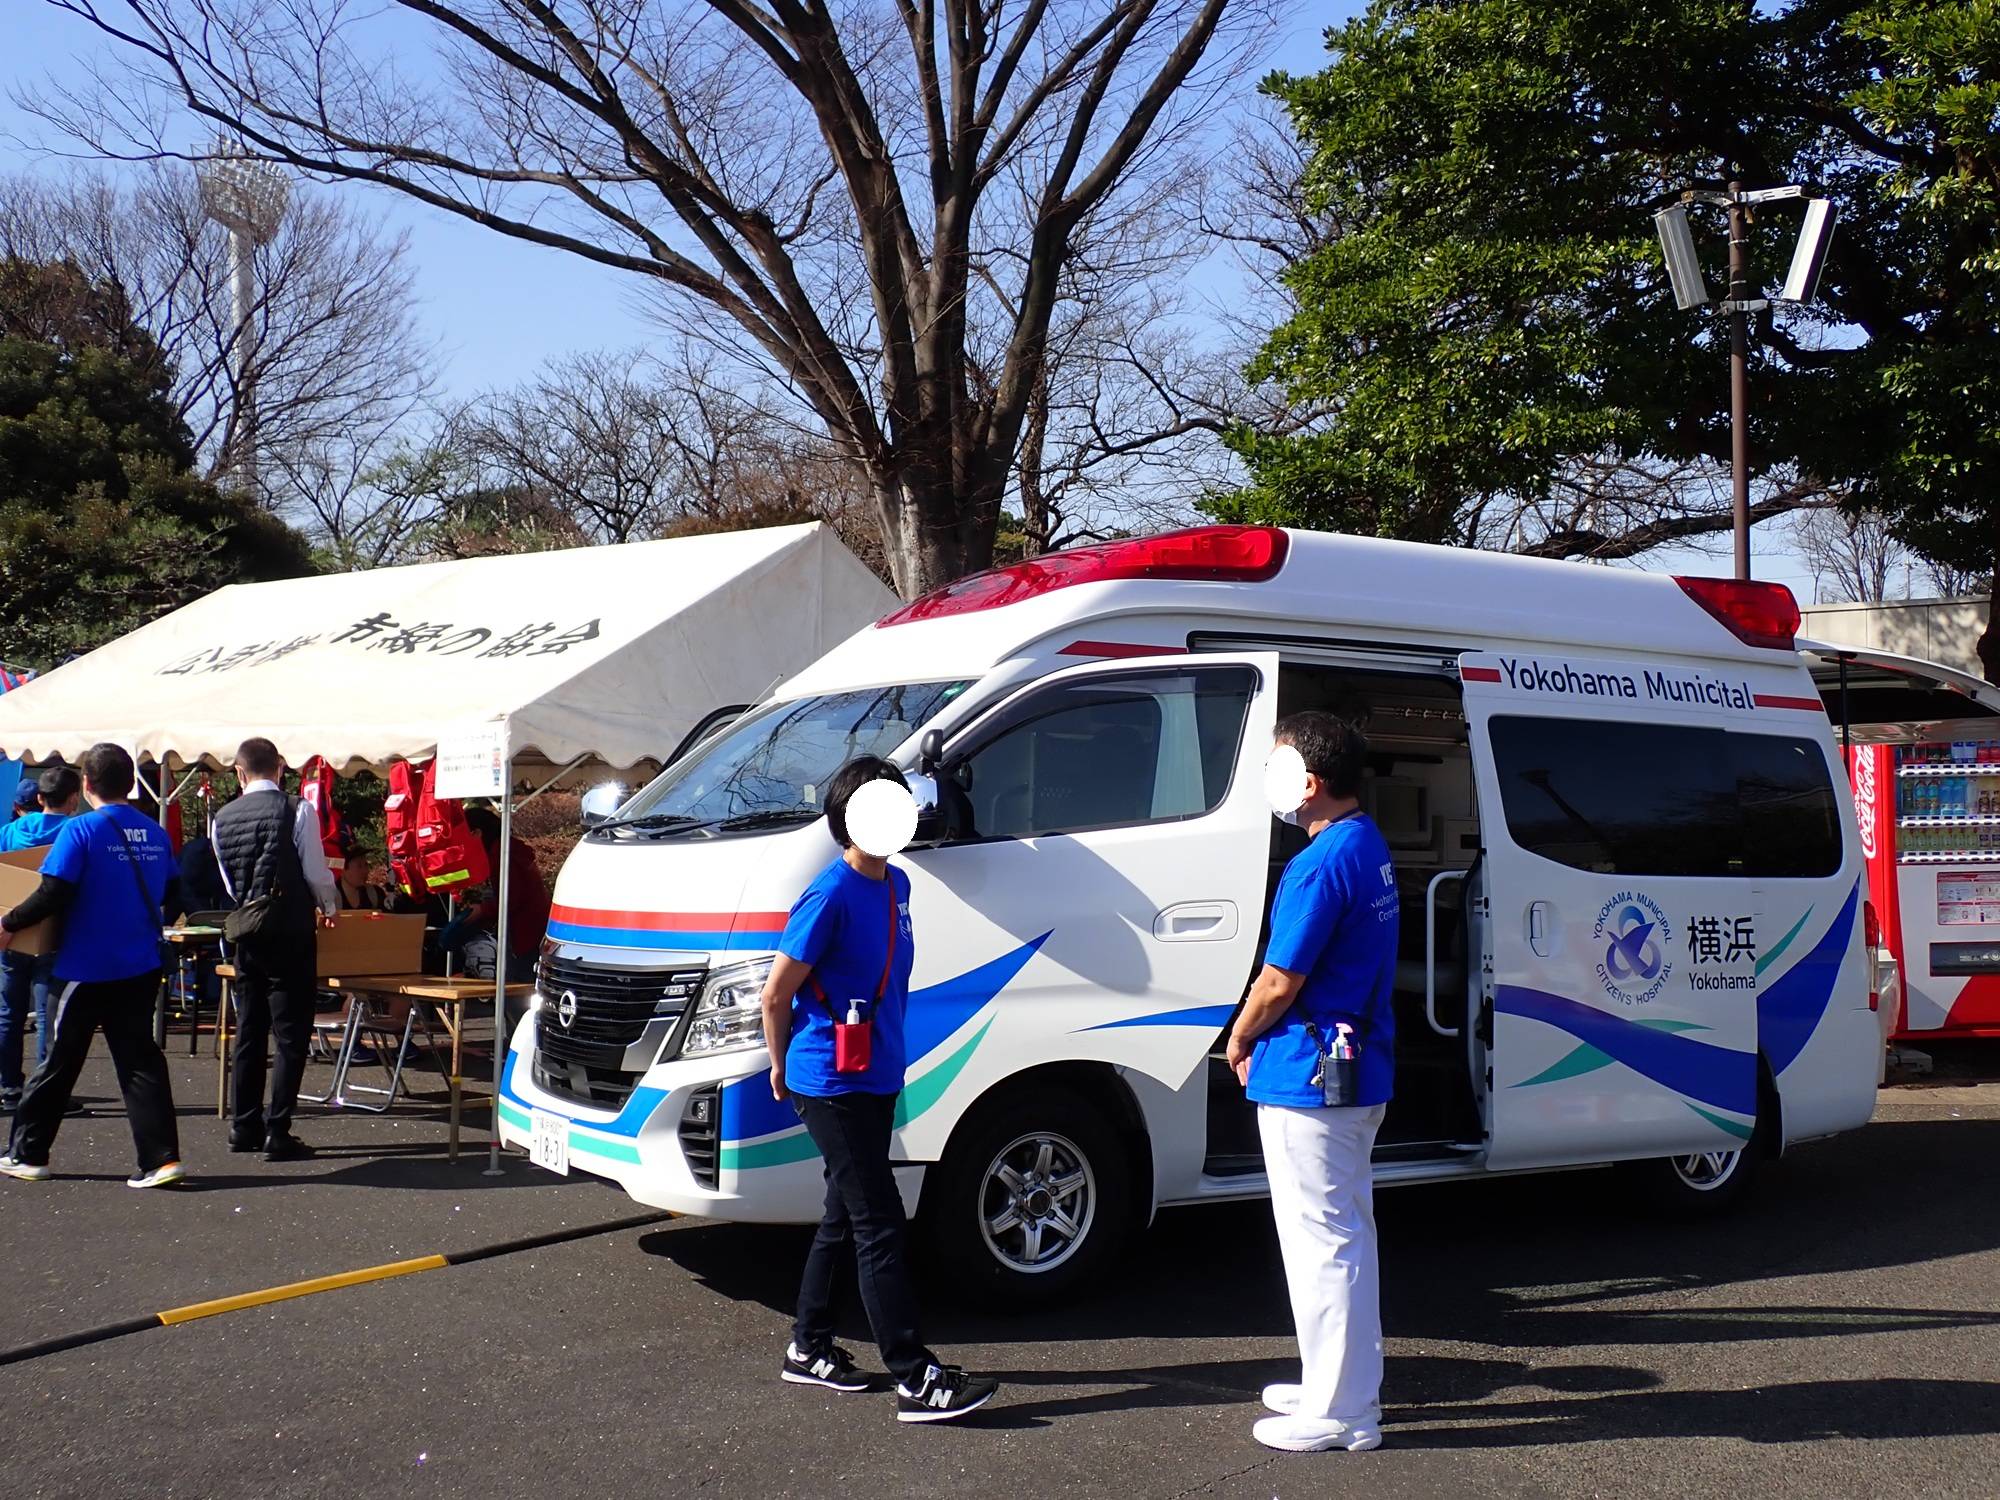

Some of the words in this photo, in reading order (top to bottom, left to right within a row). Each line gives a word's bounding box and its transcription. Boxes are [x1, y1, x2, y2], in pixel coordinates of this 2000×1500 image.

[1500, 657, 1637, 698] Yokohama
[123, 828, 147, 842] YICT
[1593, 891, 1633, 940] YOKOHAMA
[1636, 892, 1672, 944] MUNICIPAL
[1687, 916, 1756, 964] 横浜
[1636, 961, 1672, 1004] HOSPITAL
[1688, 972, 1756, 990] Yokohama
[809, 1358, 835, 1380] N
[928, 1388, 953, 1409] N
